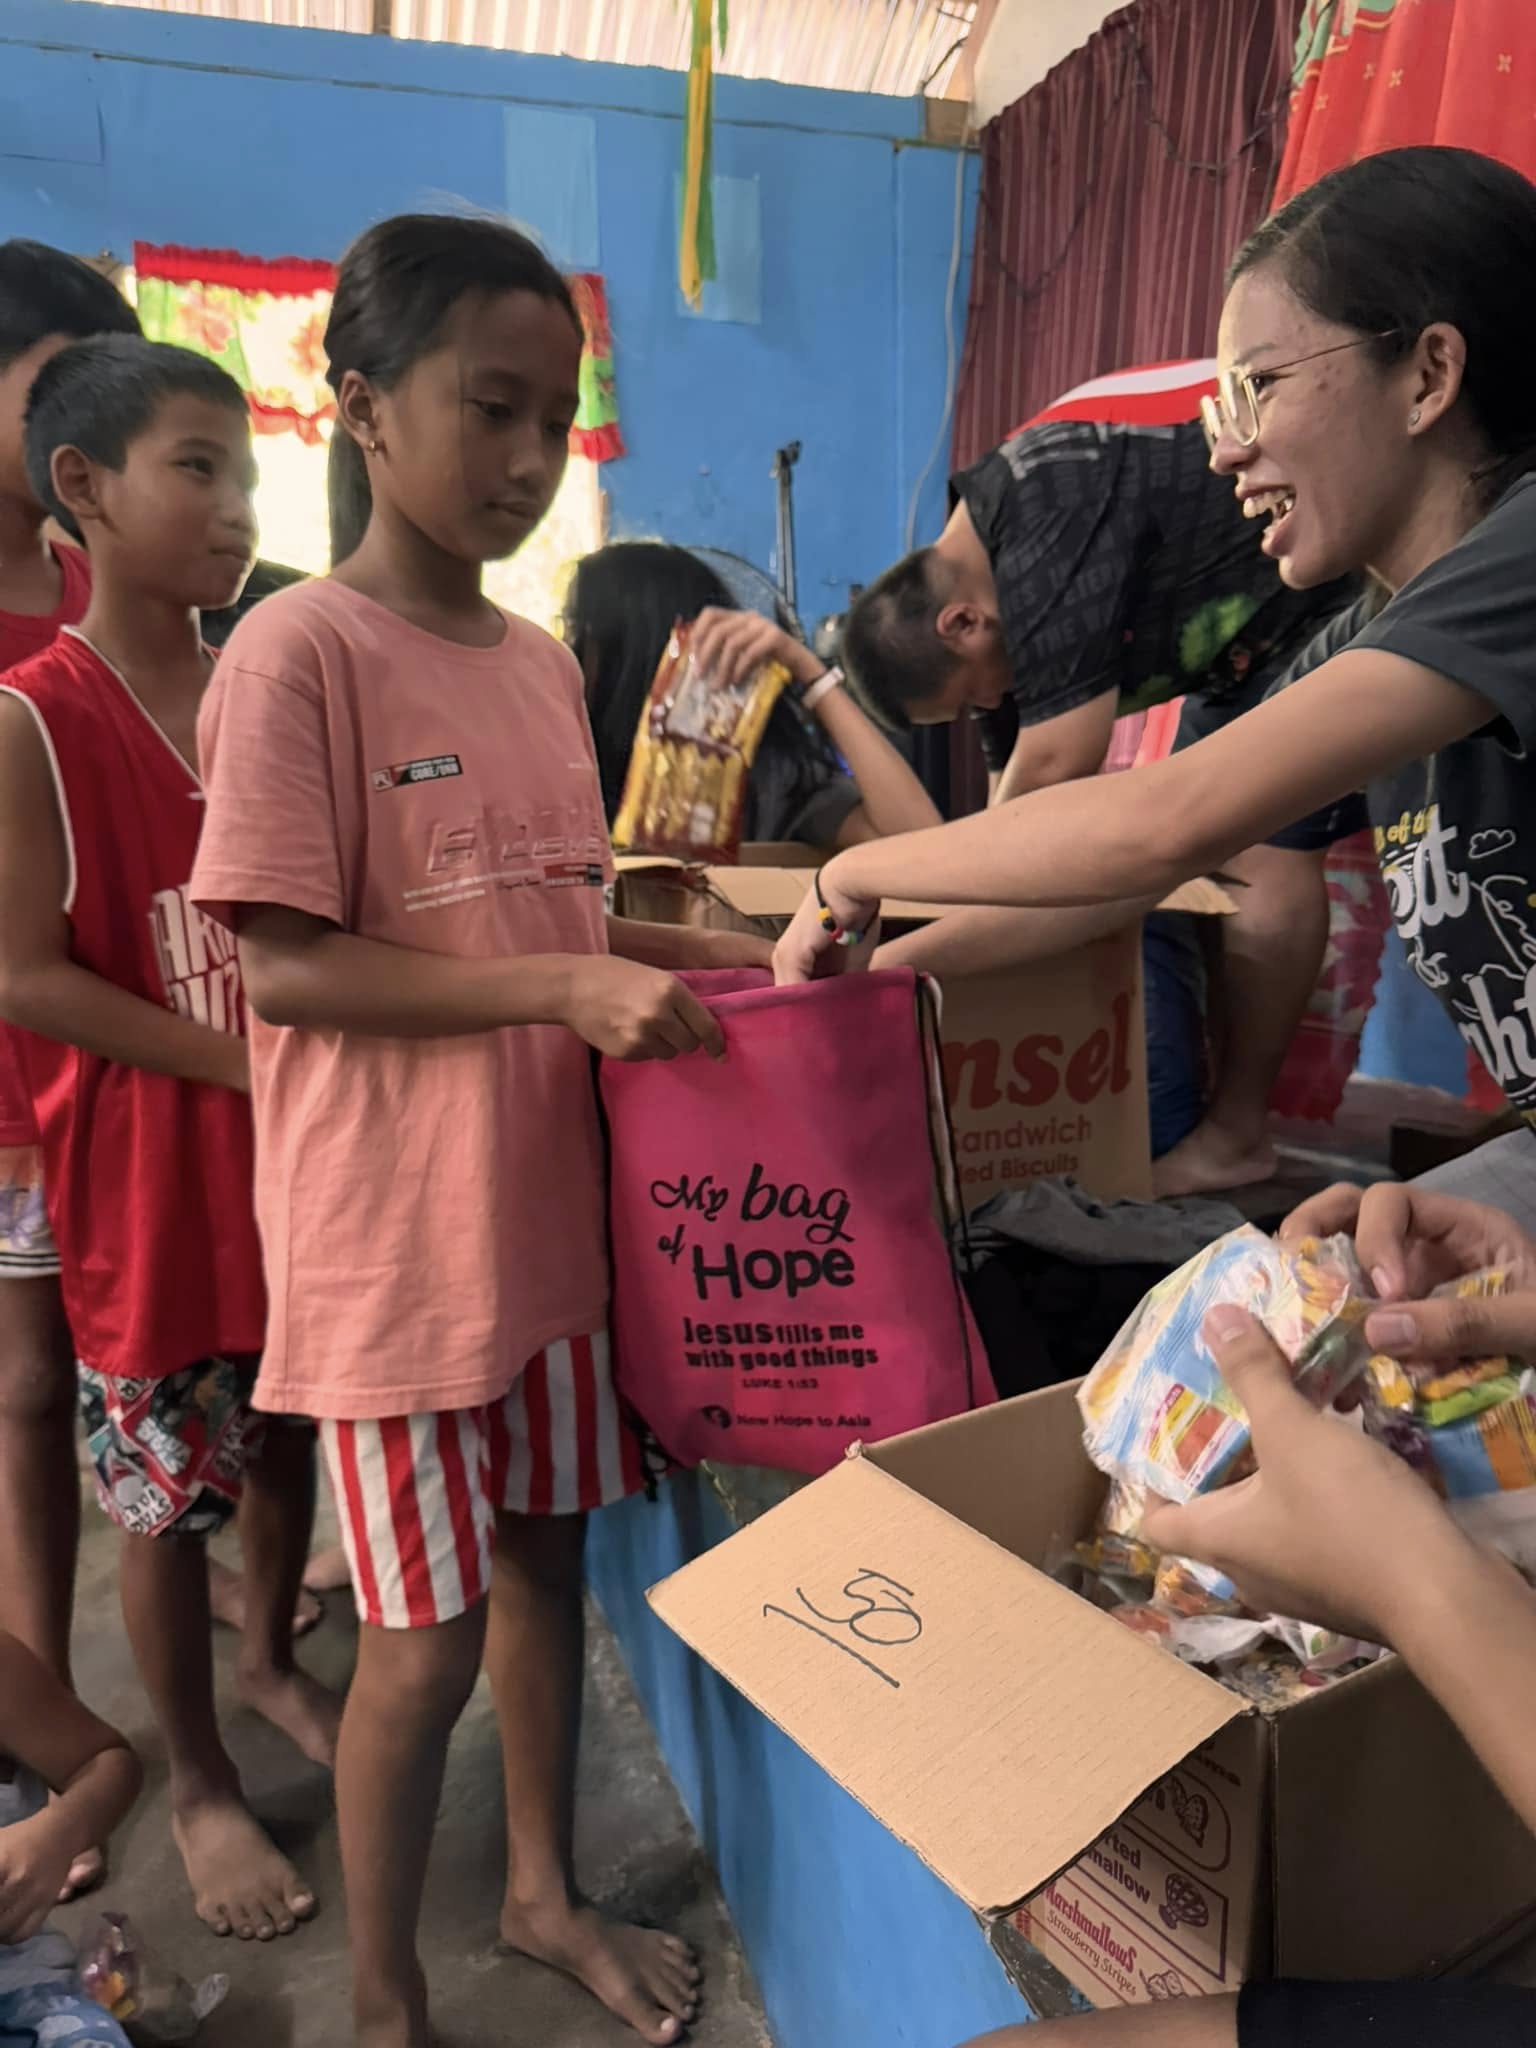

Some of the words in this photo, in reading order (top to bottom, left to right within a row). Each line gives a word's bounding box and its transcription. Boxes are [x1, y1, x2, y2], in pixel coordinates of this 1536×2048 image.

[942, 991, 1133, 1110] nsel
[954, 1113, 1092, 1154] andwich
[958, 1160, 994, 1183] ed
[1000, 1153, 1080, 1179] Biscuits
[650, 1174, 729, 1222] My
[740, 1163, 855, 1245] bag
[658, 1224, 686, 1265] of
[693, 1243, 855, 1300] Hope
[683, 1316, 774, 1345] Jesus
[776, 1323, 824, 1344] fills
[828, 1323, 865, 1341] me
[685, 1349, 735, 1368] with
[739, 1349, 797, 1371] good
[801, 1346, 879, 1368] things
[742, 1378, 782, 1389] LUKE
[736, 1414, 769, 1426] New
[774, 1413, 814, 1427] Hope
[817, 1414, 833, 1427] to
[836, 1413, 872, 1428] Asia
[1086, 1845, 1151, 1905] mallow
[1046, 1908, 1102, 1969] Strawberry
[1100, 1957, 1138, 1997] Stripes
